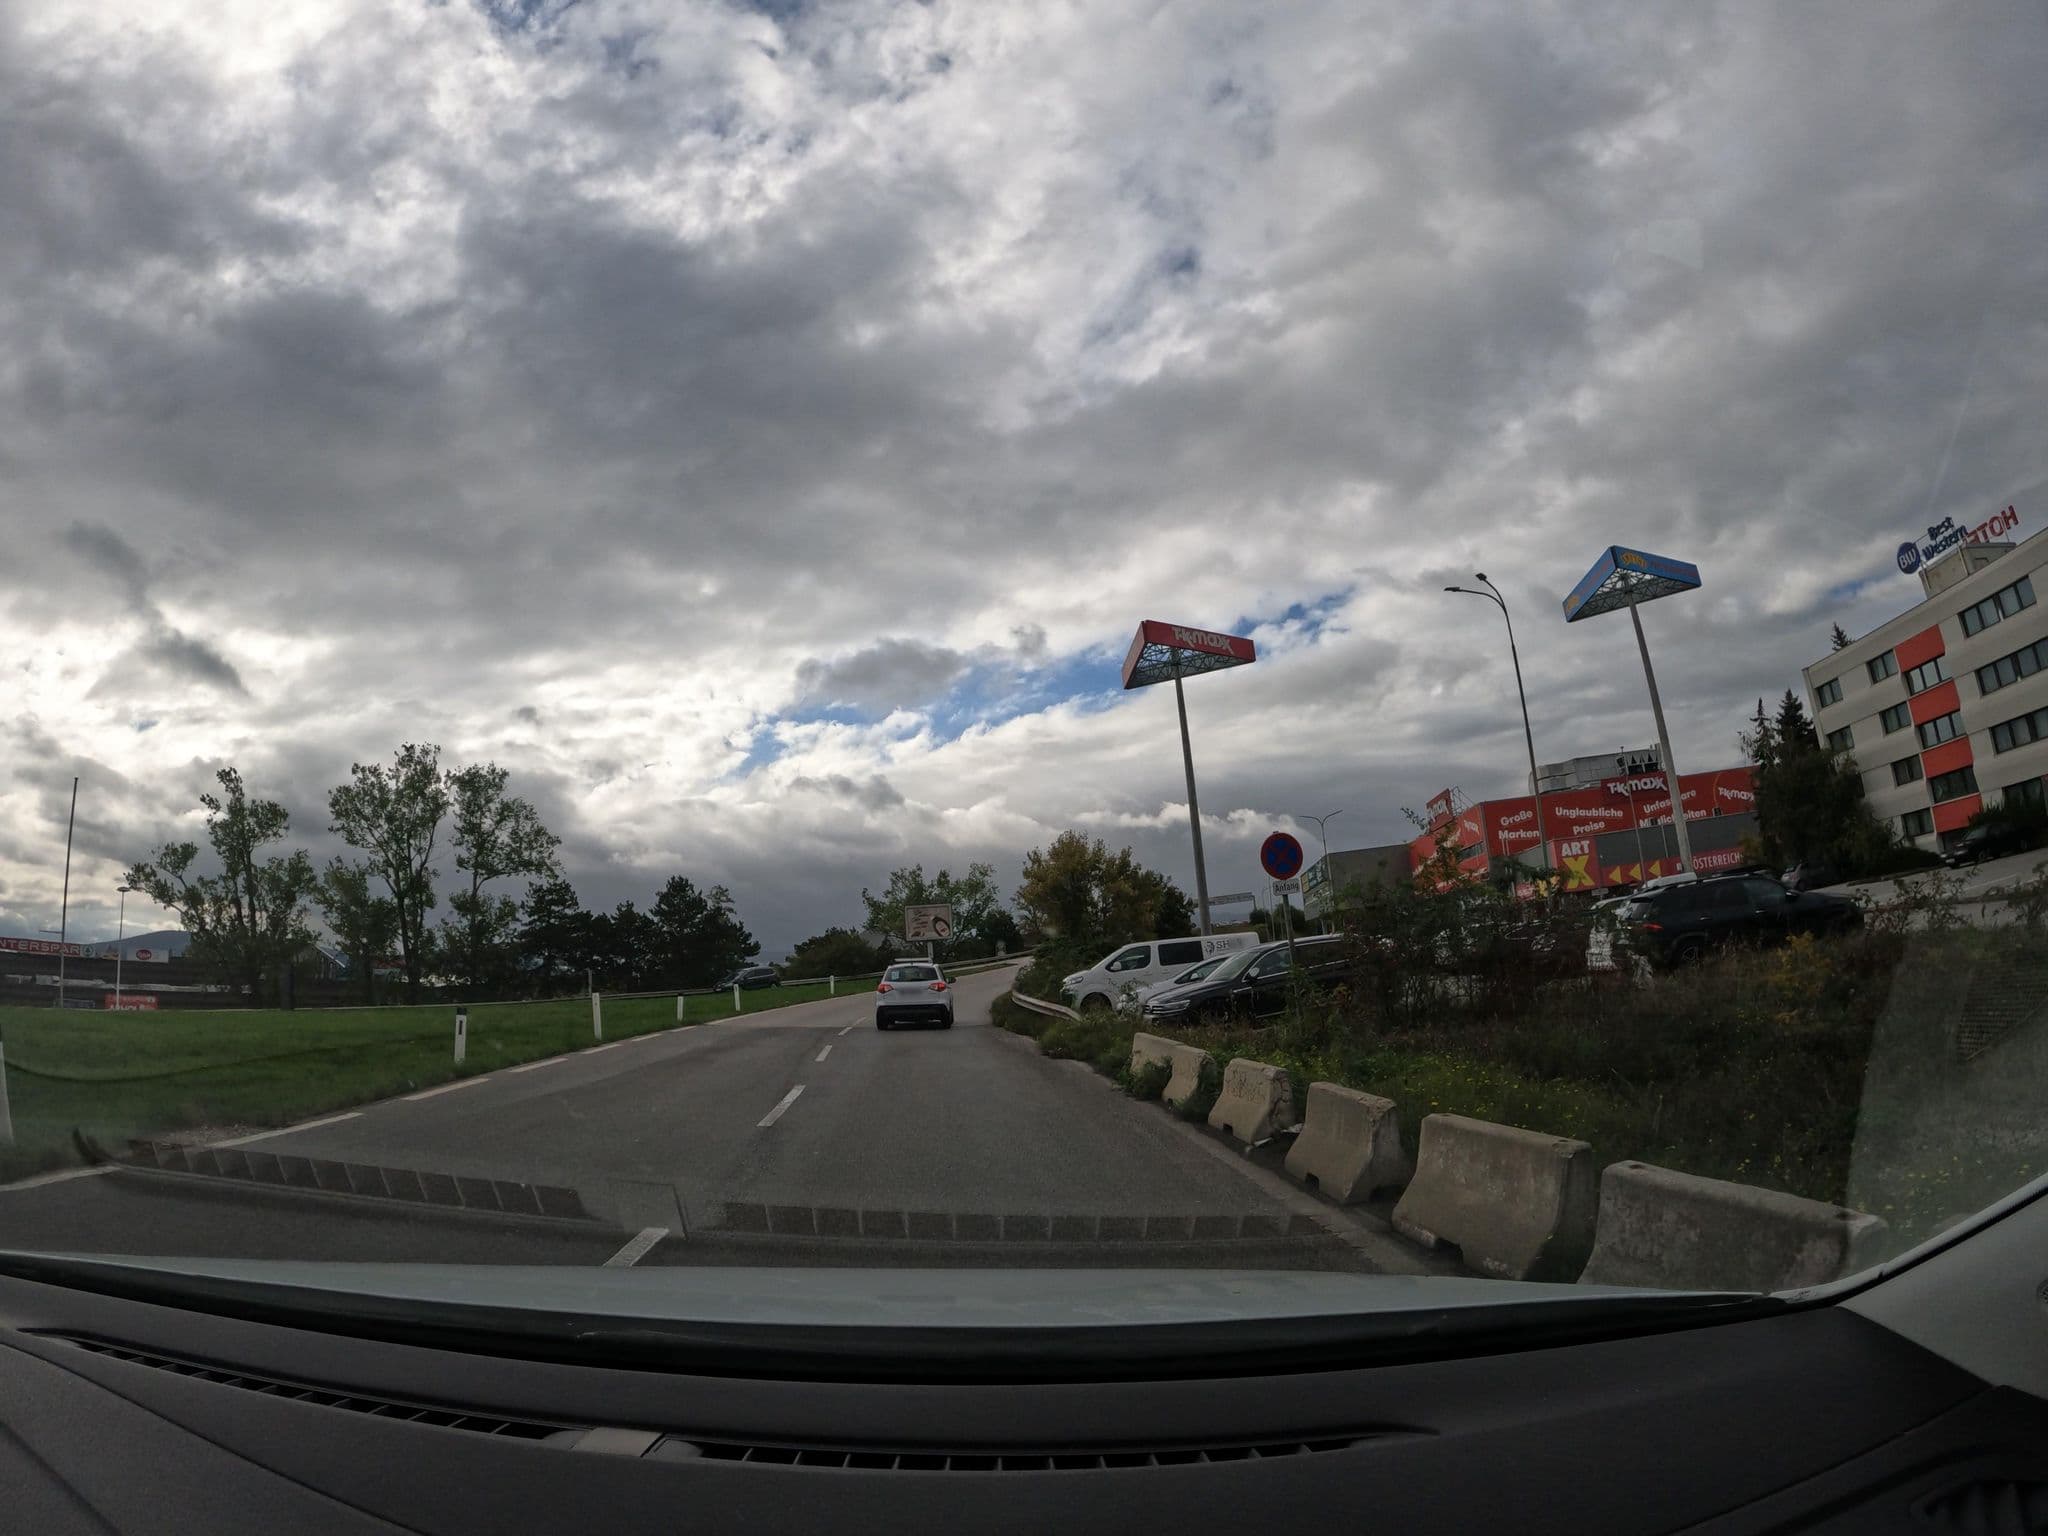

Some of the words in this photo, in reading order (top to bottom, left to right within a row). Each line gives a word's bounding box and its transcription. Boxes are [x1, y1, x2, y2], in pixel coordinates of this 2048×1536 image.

[1927, 517, 1954, 540] Best
[1922, 525, 1968, 560] Western
[1898, 547, 1917, 569] BW
[1500, 810, 1533, 826] Große
[1555, 806, 1624, 818] Unglaubliche
[1498, 829, 1540, 841] Marken
[1572, 820, 1605, 835] Preise
[1561, 840, 1590, 857] ART
[1562, 855, 1595, 889] X
[1275, 881, 1299, 893] Anfang
